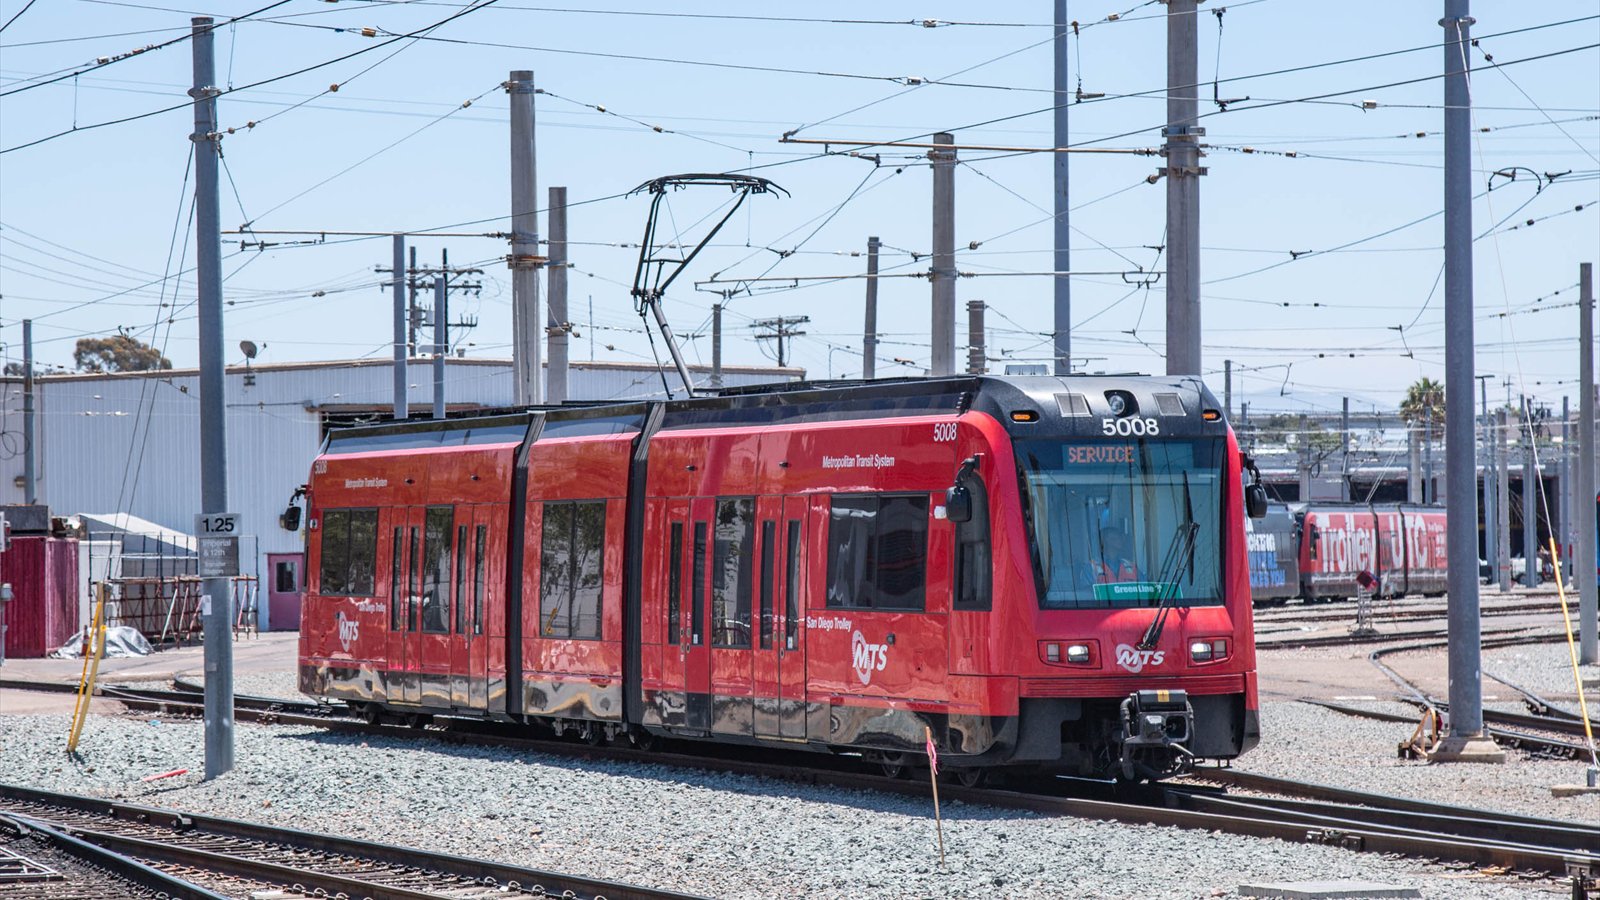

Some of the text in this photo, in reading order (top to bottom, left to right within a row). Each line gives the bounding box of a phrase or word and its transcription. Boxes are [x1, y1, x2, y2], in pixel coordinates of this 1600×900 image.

[933, 423, 957, 442] 5008
[1102, 418, 1159, 436] 5008
[823, 453, 894, 470] Metropolitan Transit System
[1068, 446, 1135, 464] SERVICE
[202, 517, 234, 532] 1.25
[1316, 512, 1428, 574] Trolley UTC
[1114, 585, 1154, 594] Green Line
[340, 621, 359, 641] MTS
[807, 616, 852, 632] San Diego Trolley
[852, 642, 888, 671] MTS
[1116, 650, 1165, 666] MTS
